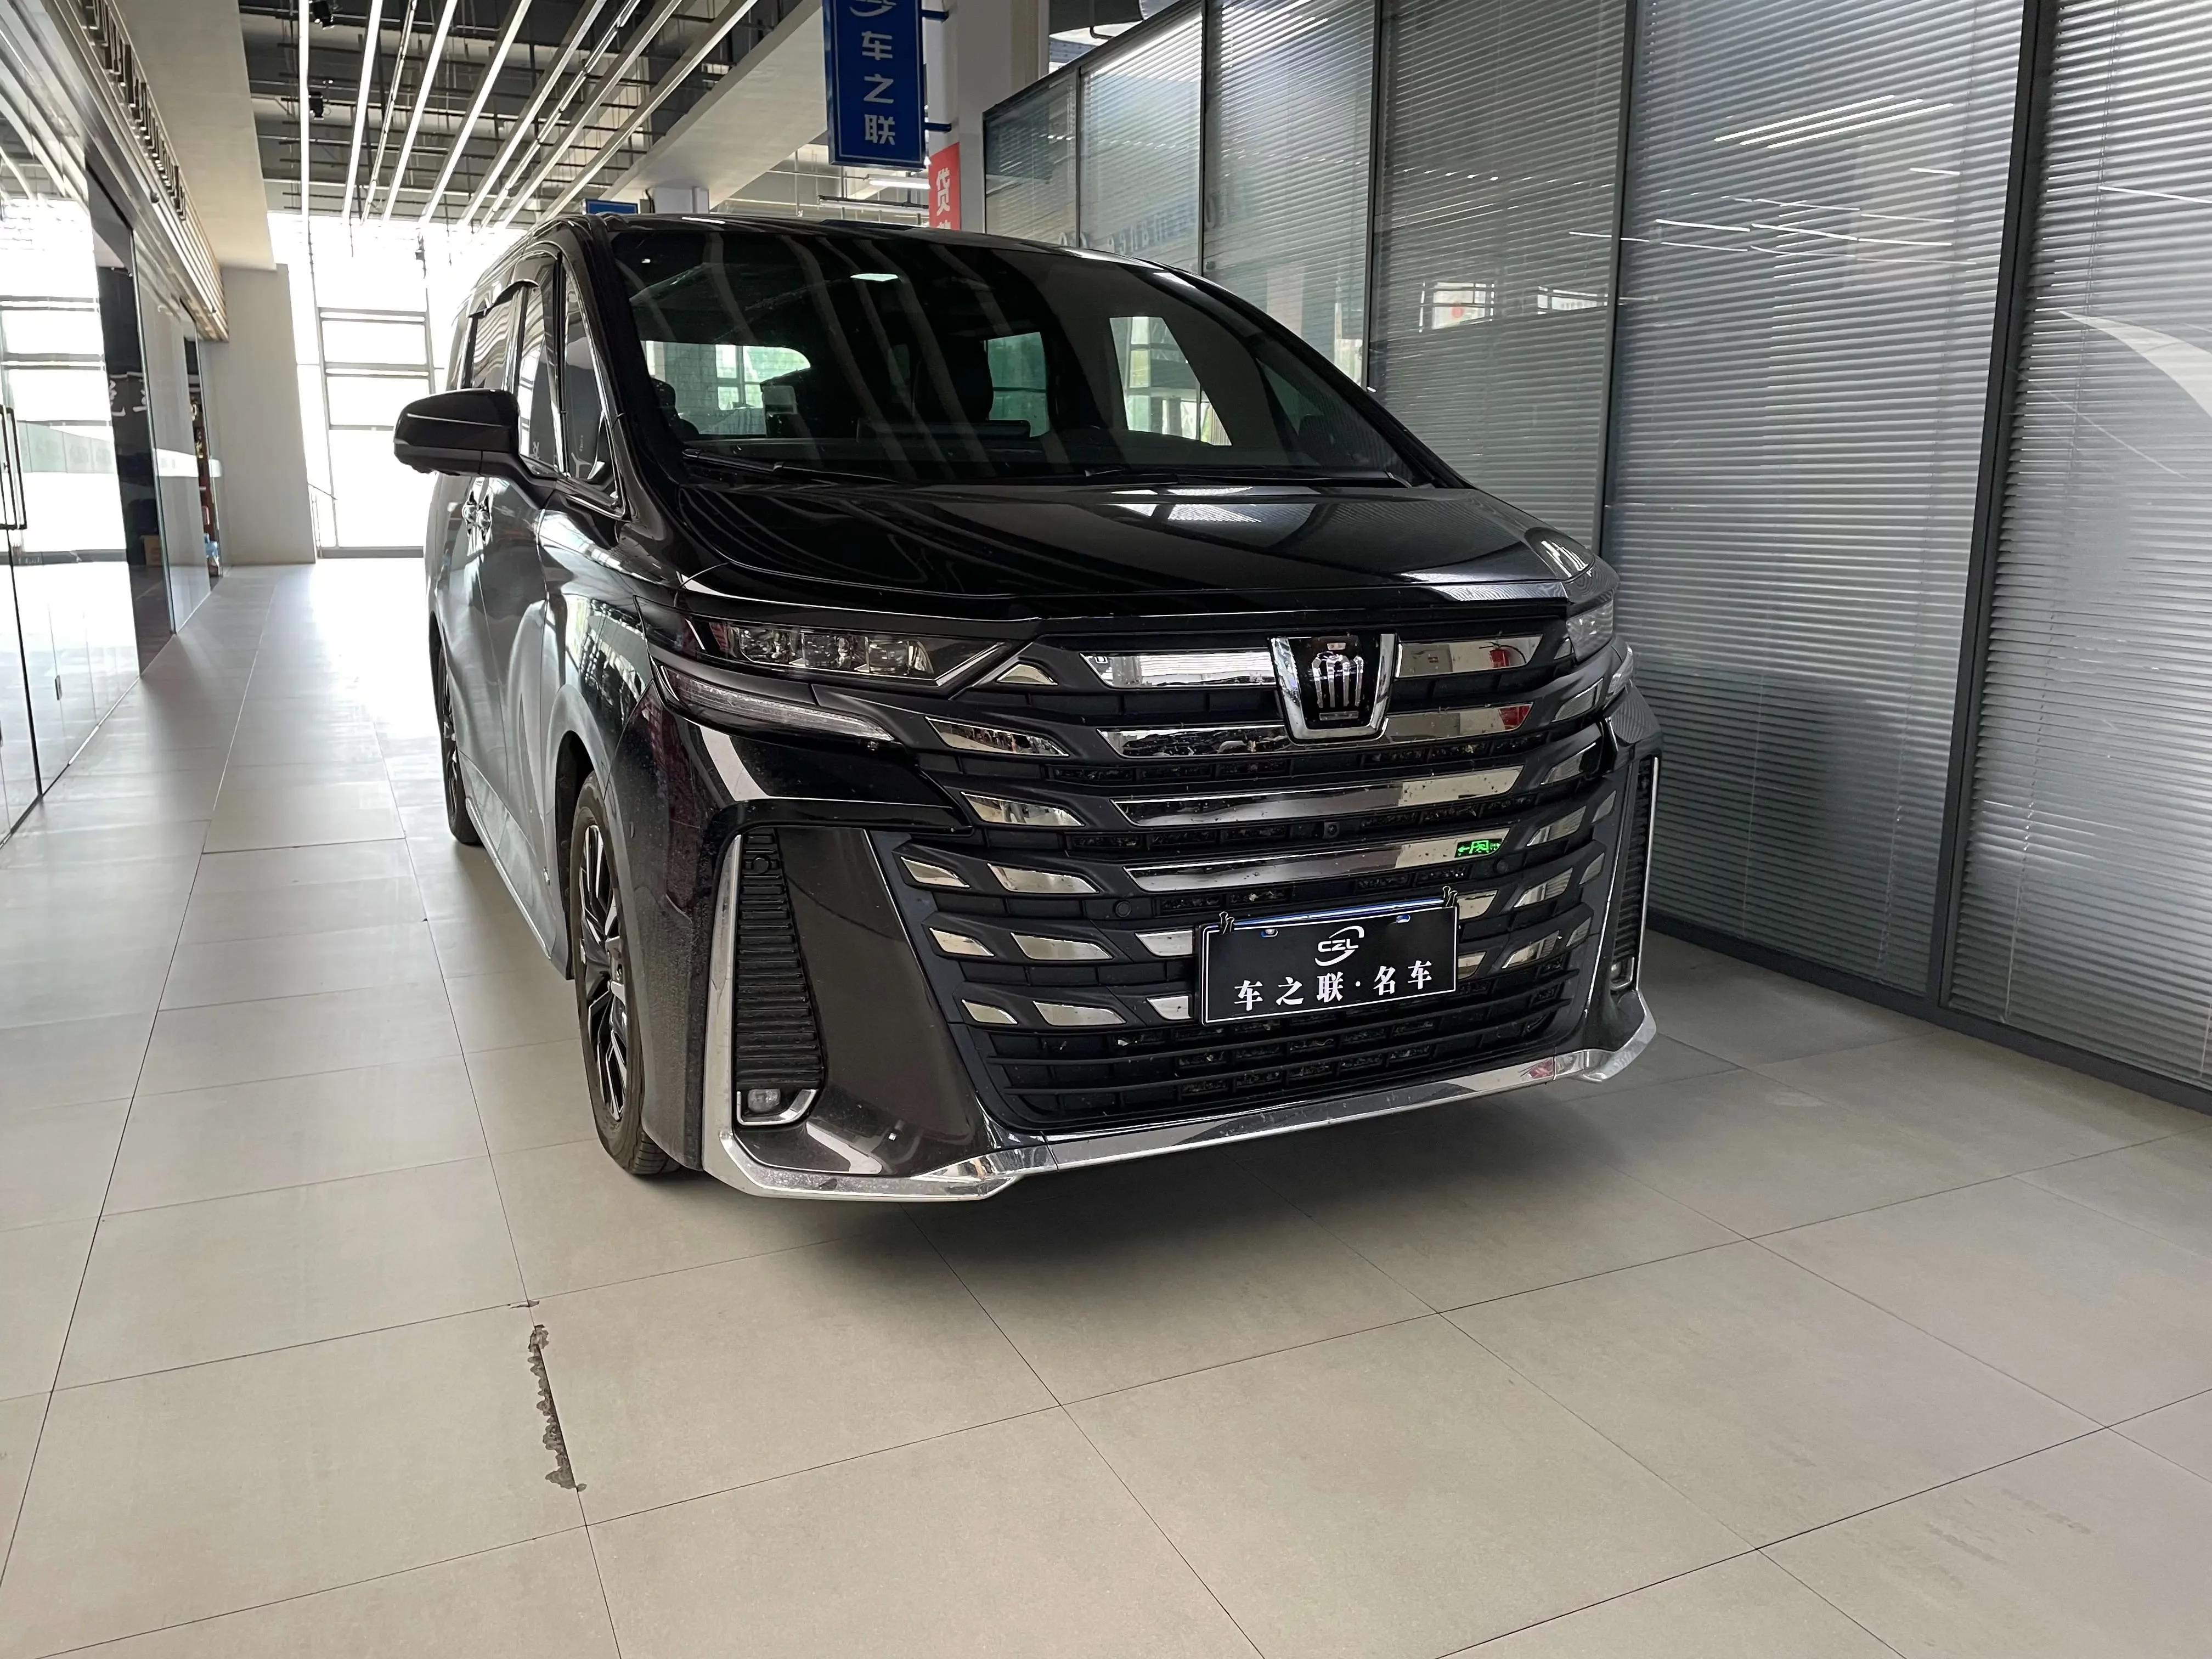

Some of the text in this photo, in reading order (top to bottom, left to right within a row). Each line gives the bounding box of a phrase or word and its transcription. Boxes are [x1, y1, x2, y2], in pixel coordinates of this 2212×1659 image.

[861, 30, 896, 145] 车之联
[1318, 939, 1359, 952] CZL
